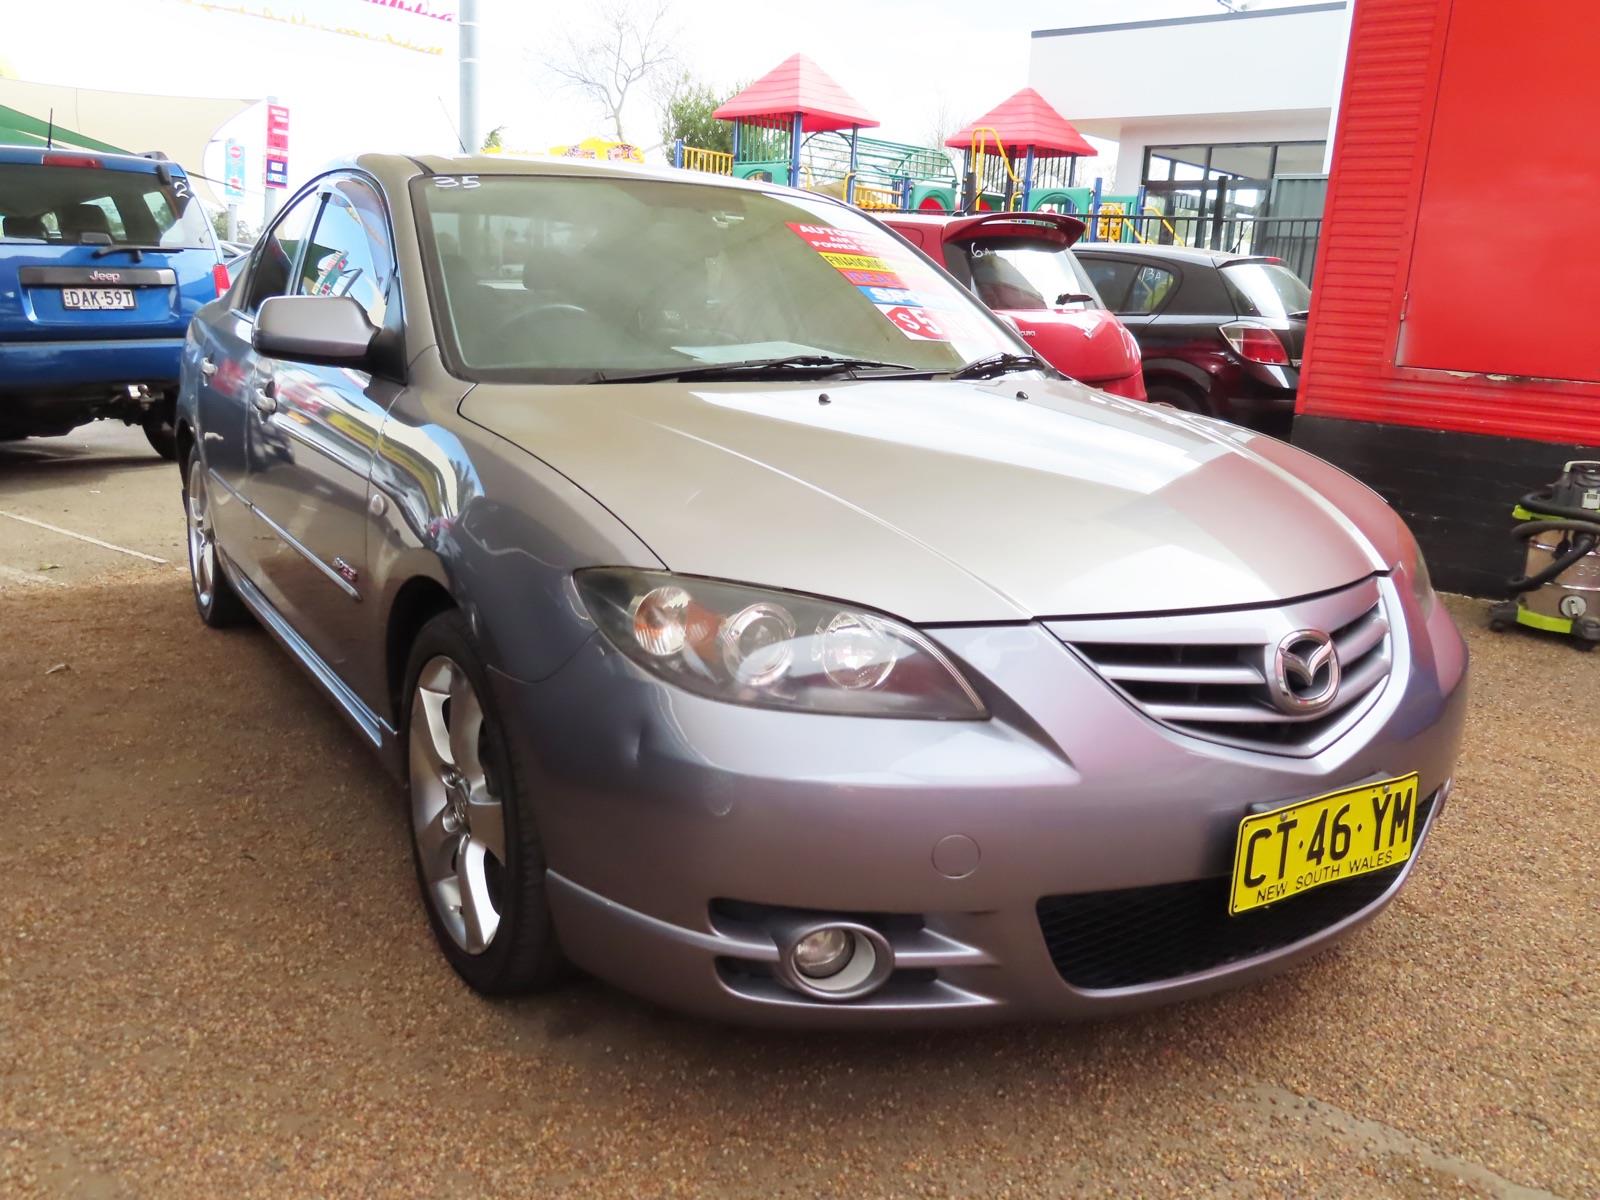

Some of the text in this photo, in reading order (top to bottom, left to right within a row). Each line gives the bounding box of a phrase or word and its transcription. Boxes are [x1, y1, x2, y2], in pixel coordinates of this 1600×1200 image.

[174, 181, 189, 199] 2
[432, 175, 481, 189] 35
[89, 270, 121, 283] Jeep
[1256, 849, 1393, 903] NEW SOUTH WALES
